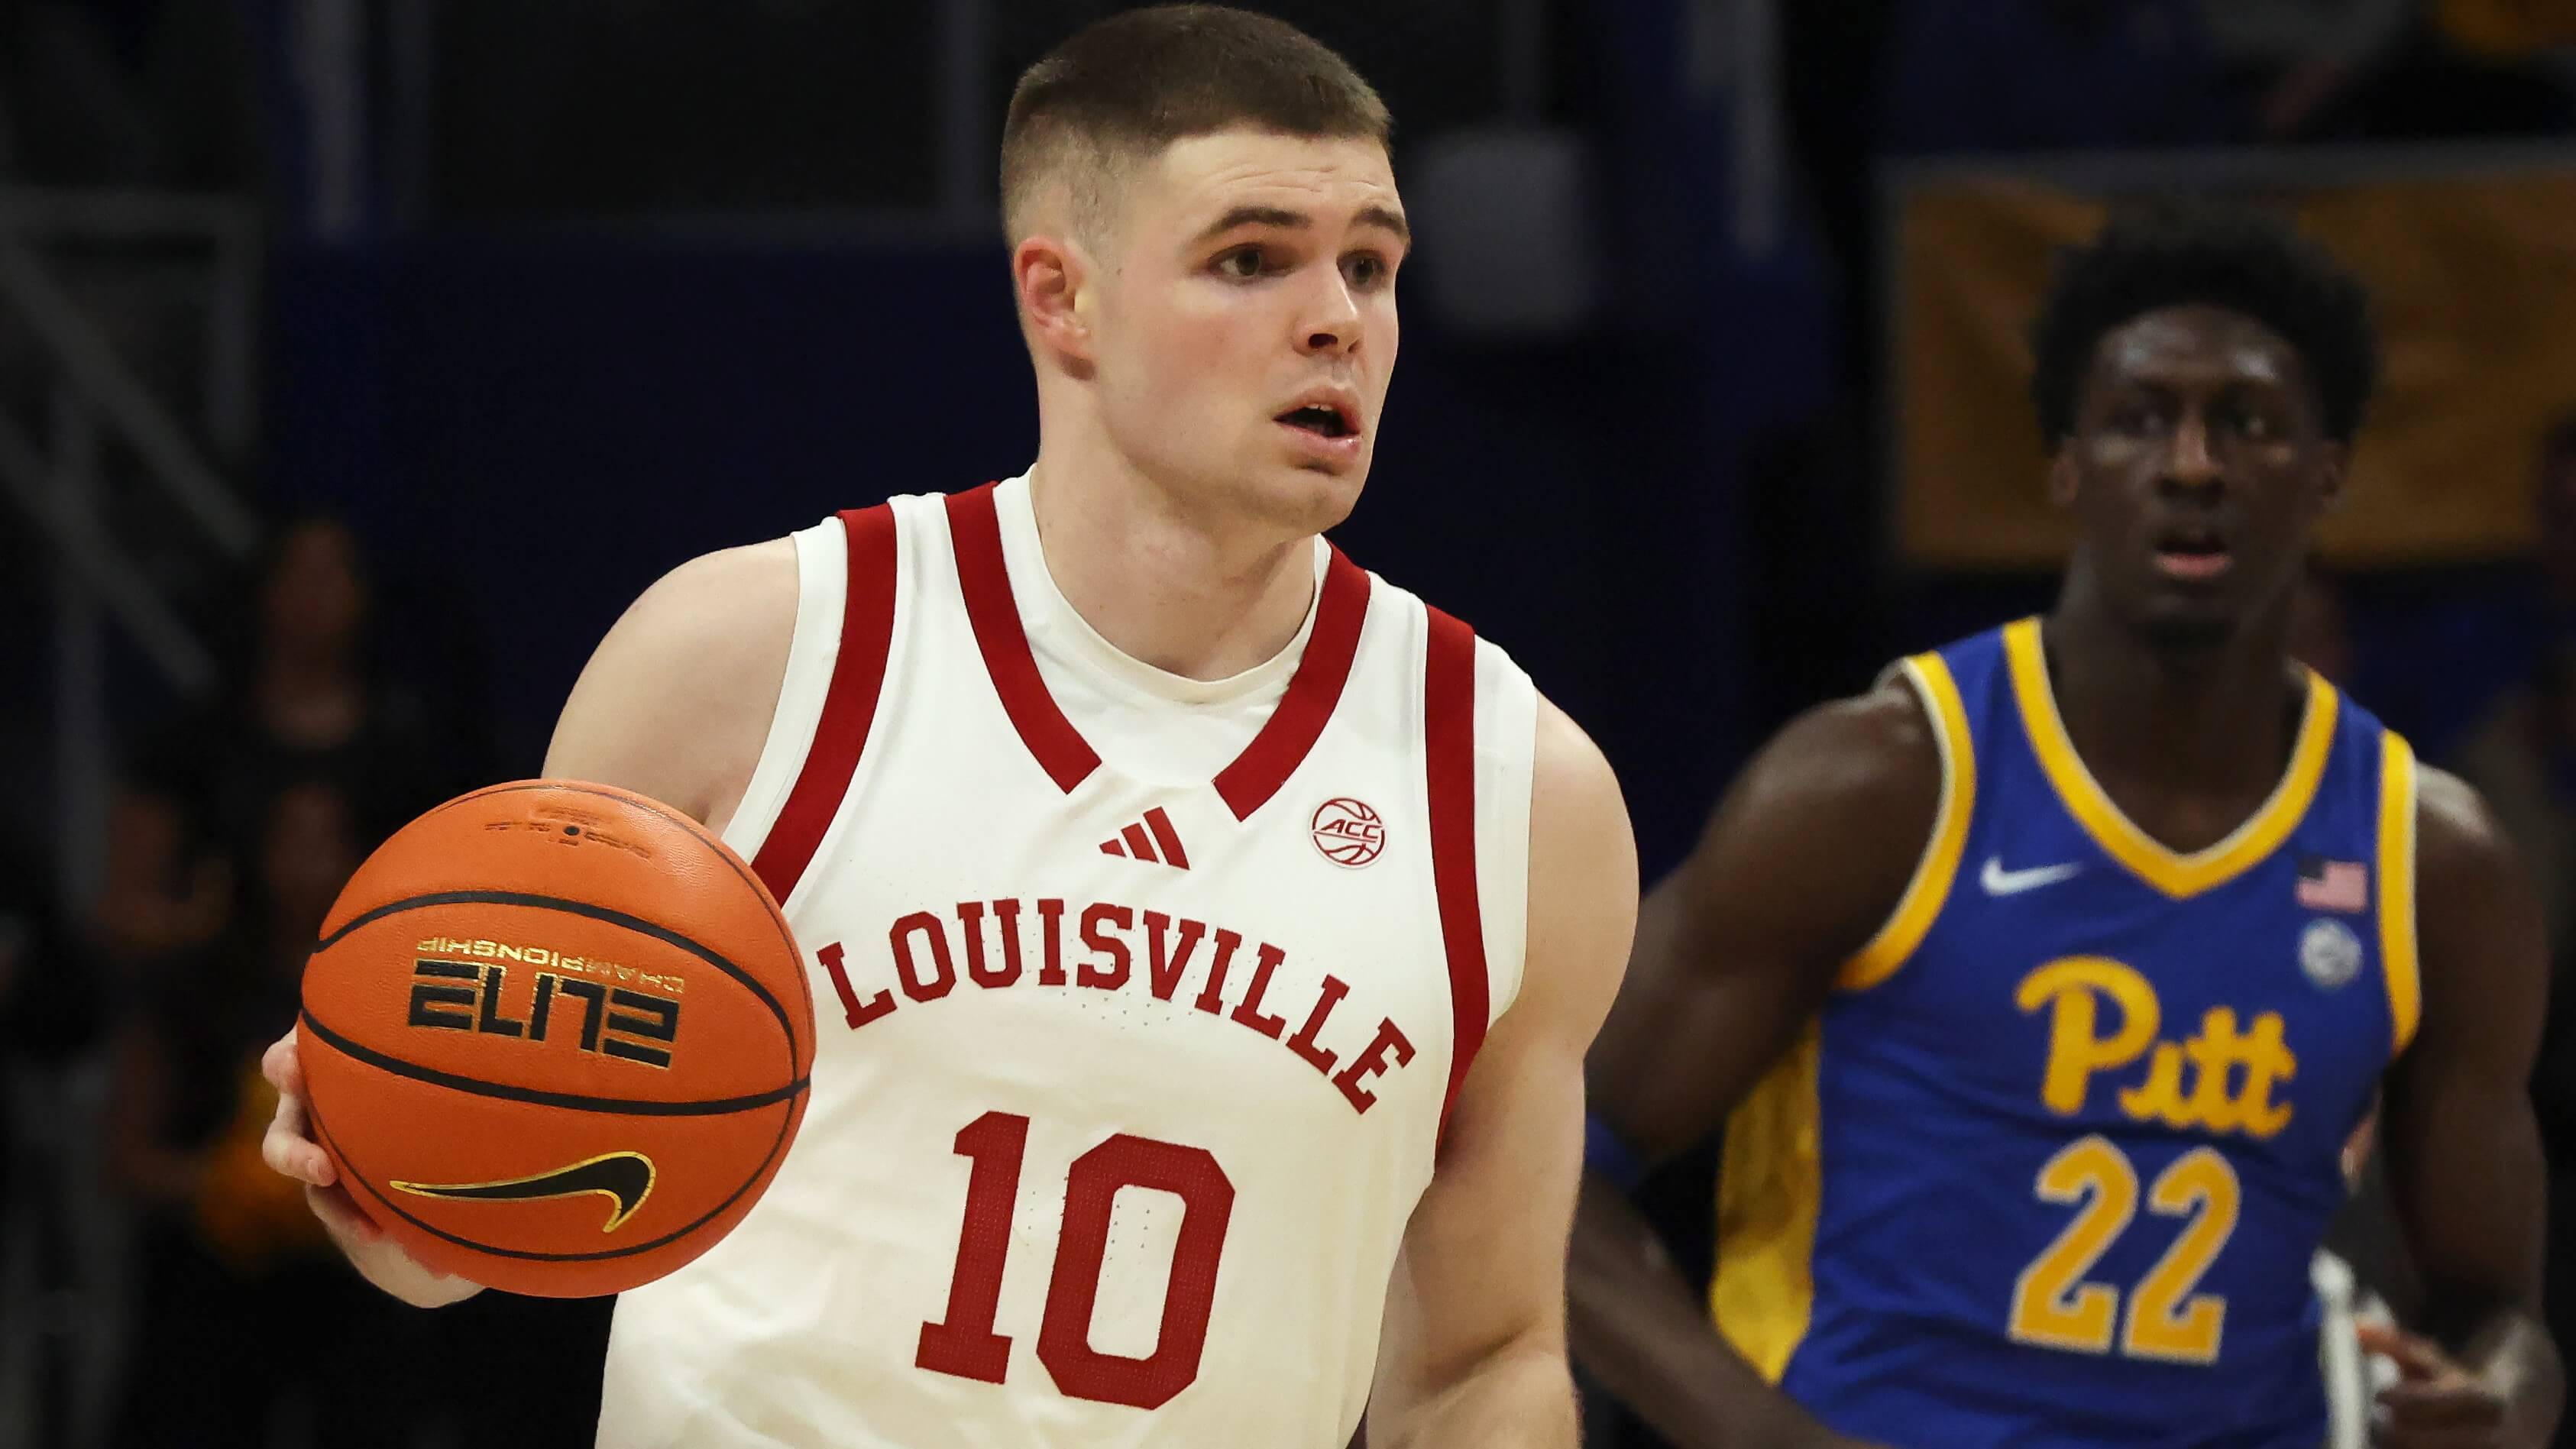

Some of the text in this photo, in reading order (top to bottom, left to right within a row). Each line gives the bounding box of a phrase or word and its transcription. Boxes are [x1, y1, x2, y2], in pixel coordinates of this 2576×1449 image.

[1321, 819, 1383, 839] ACC
[409, 959, 681, 1070] ELITE
[417, 936, 684, 995] CHAMPIONSHIP
[817, 898, 1416, 1114] LOUISVILLE
[2015, 953, 2296, 1139] Pitt
[915, 1110, 1235, 1410] 10
[2008, 1134, 2241, 1364] 22
